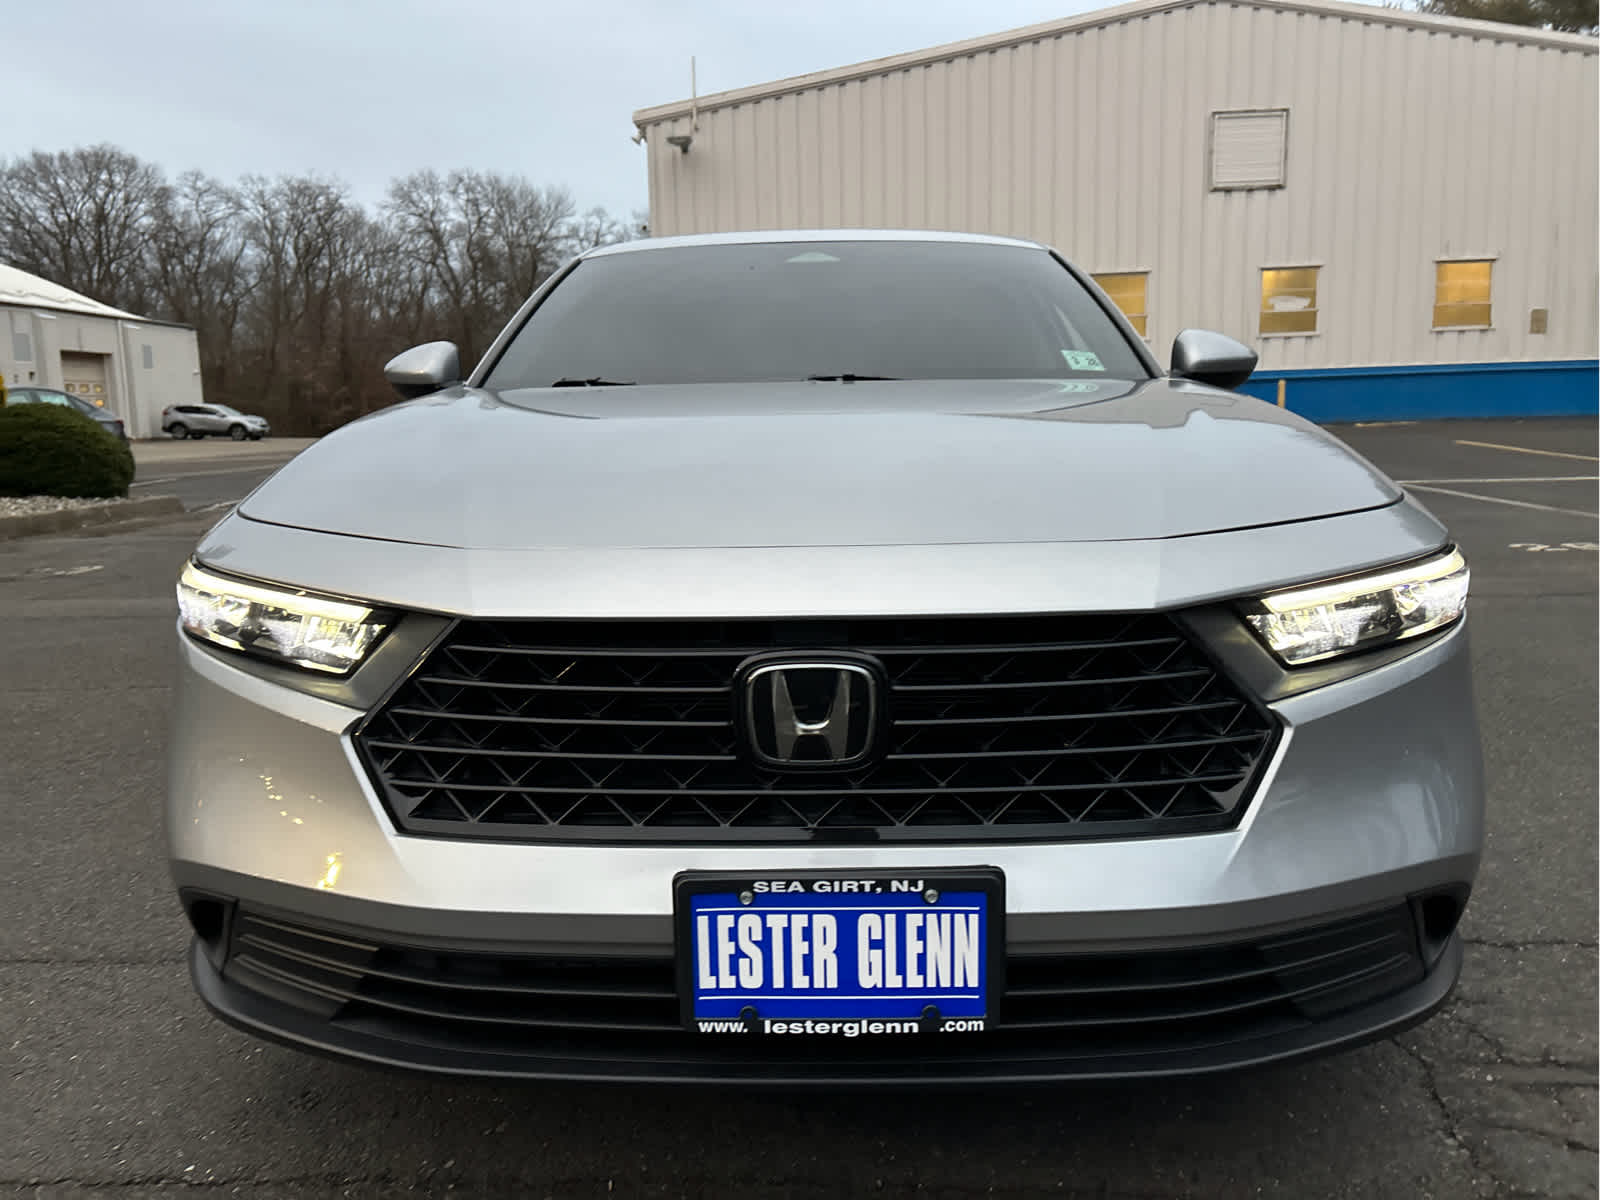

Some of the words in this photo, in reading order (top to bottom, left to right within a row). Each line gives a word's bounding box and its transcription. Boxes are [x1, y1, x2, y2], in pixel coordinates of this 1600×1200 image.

[752, 880, 806, 893] SEA
[812, 880, 882, 894] GIRT,
[890, 879, 924, 892] NJ
[697, 913, 838, 989] LESTER
[857, 913, 979, 988] GLENN
[698, 1021, 748, 1033] www.
[764, 1019, 919, 1037] lesterglenn
[939, 1019, 984, 1032] .com
